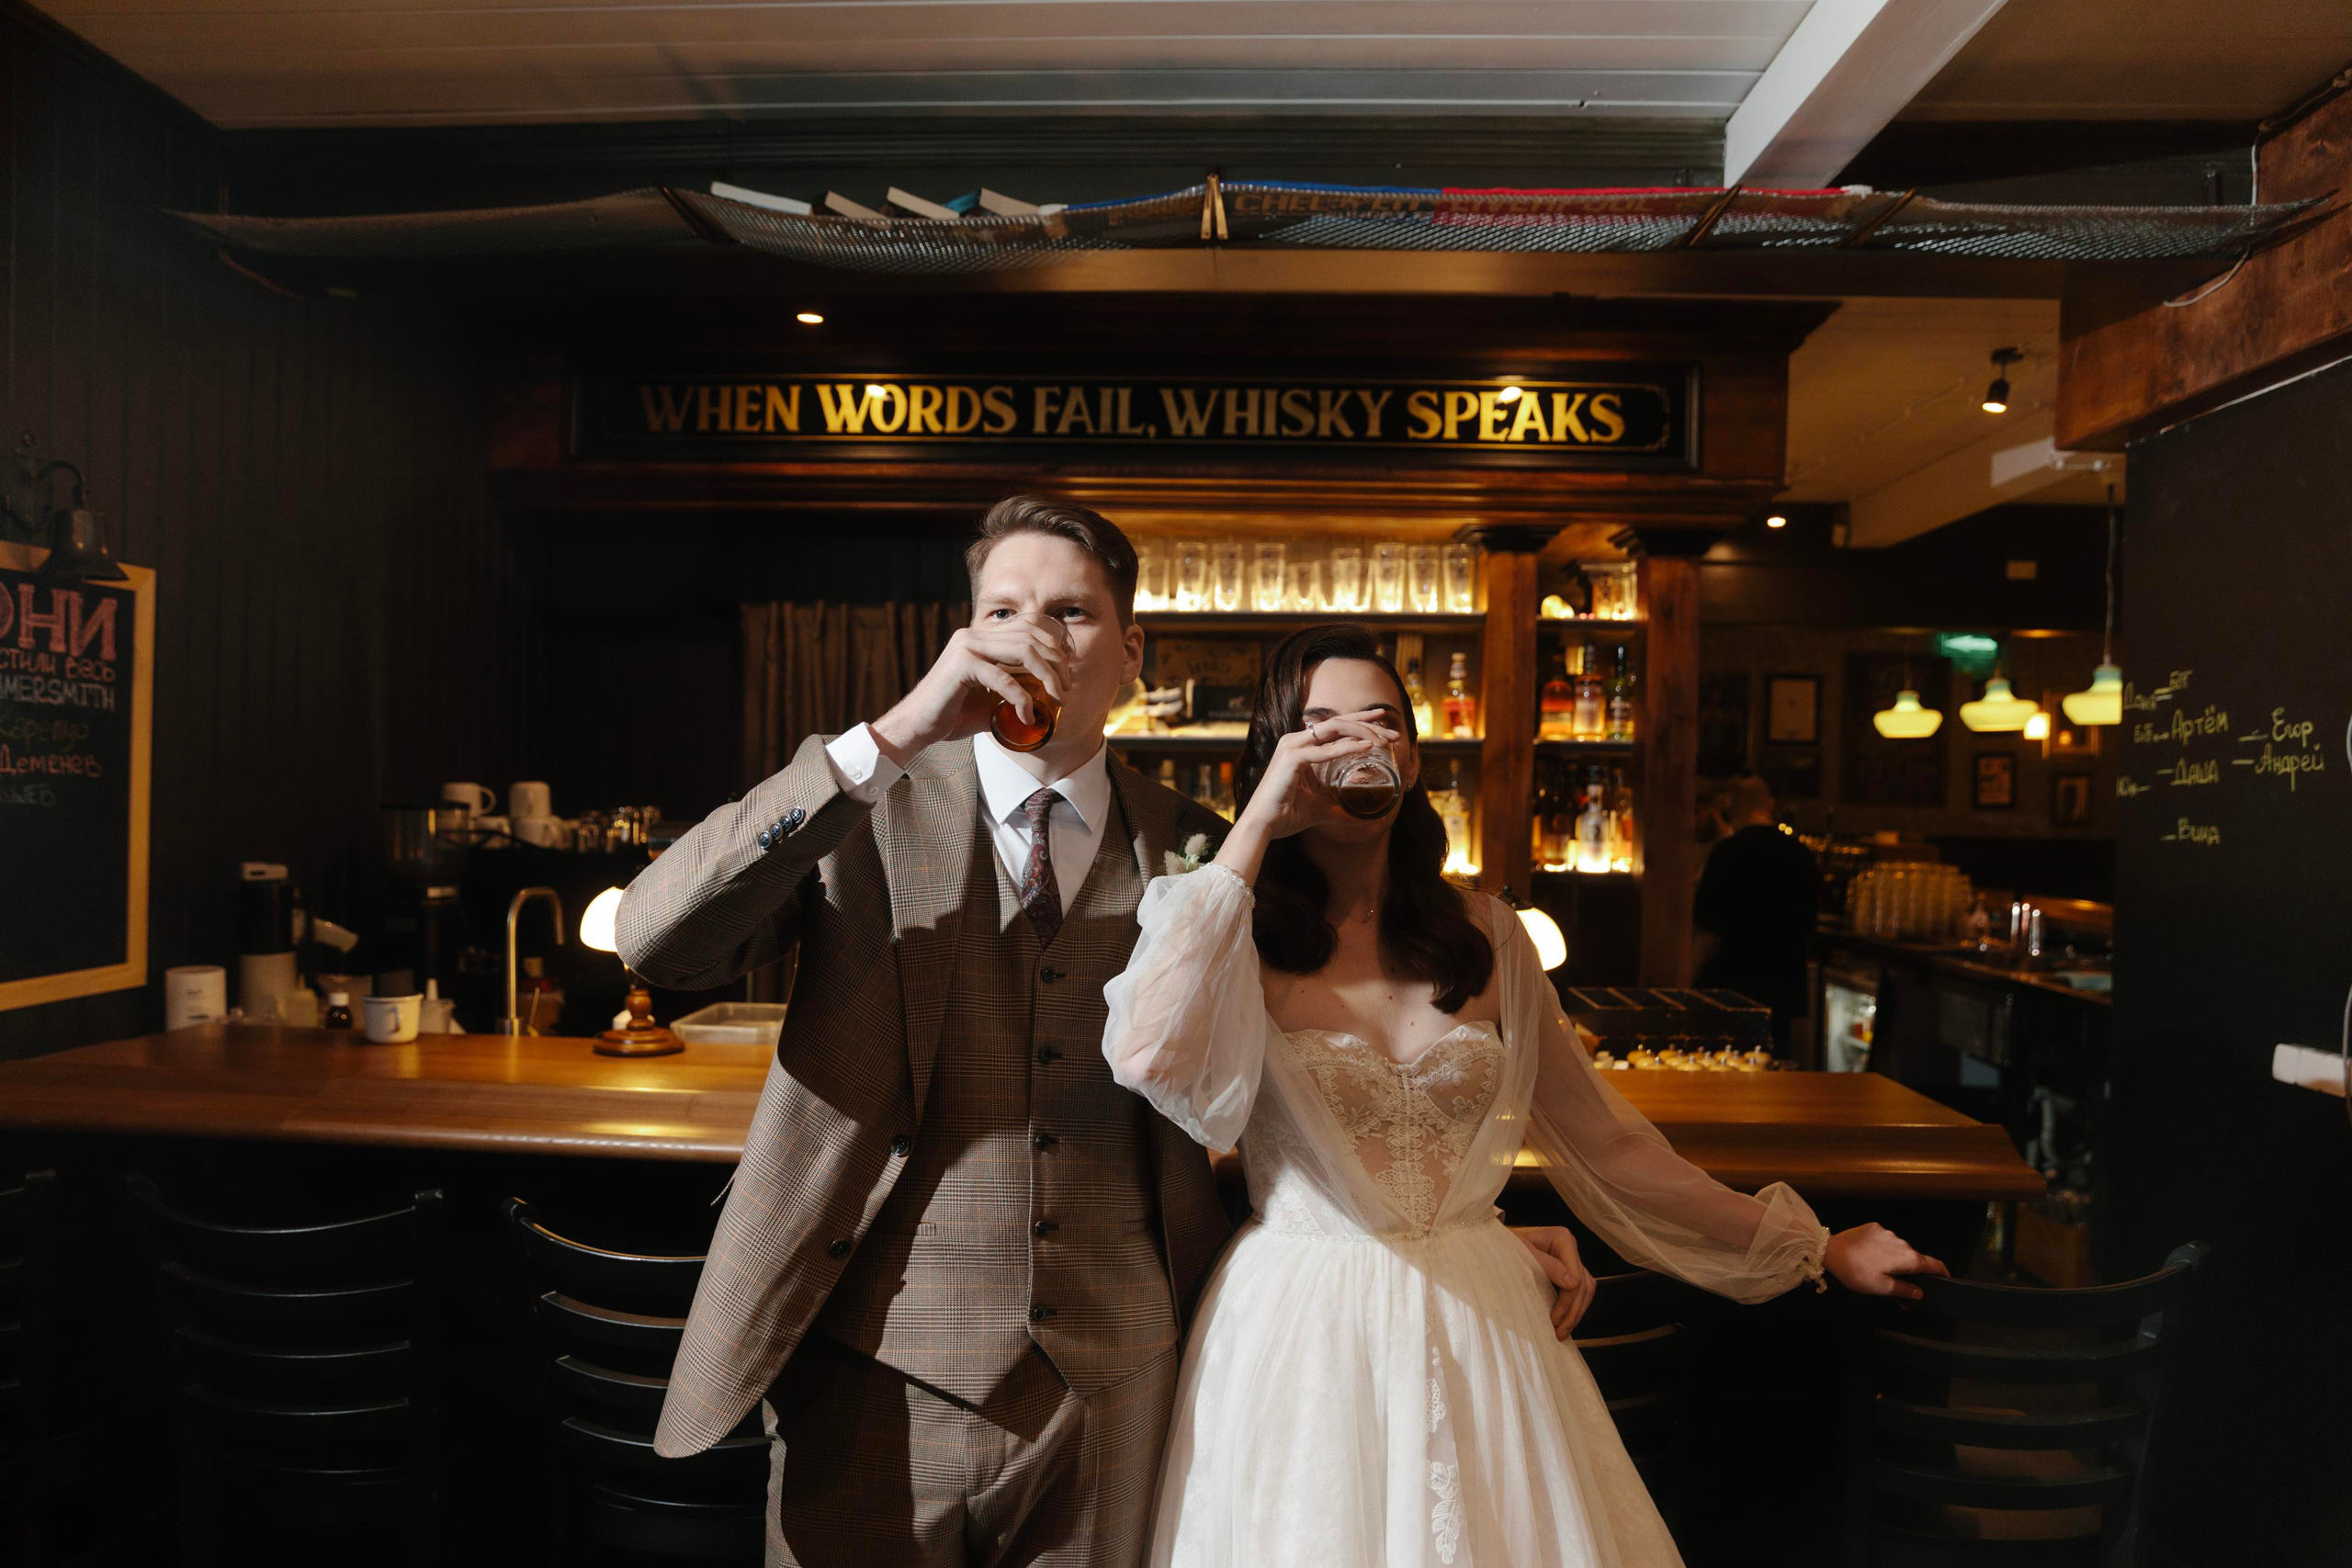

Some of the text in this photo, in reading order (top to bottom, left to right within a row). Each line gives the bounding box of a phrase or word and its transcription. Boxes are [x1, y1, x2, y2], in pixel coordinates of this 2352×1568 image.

[640, 383, 1625, 443] WHEN WORDS FAIL, WHISKY SPEAKS
